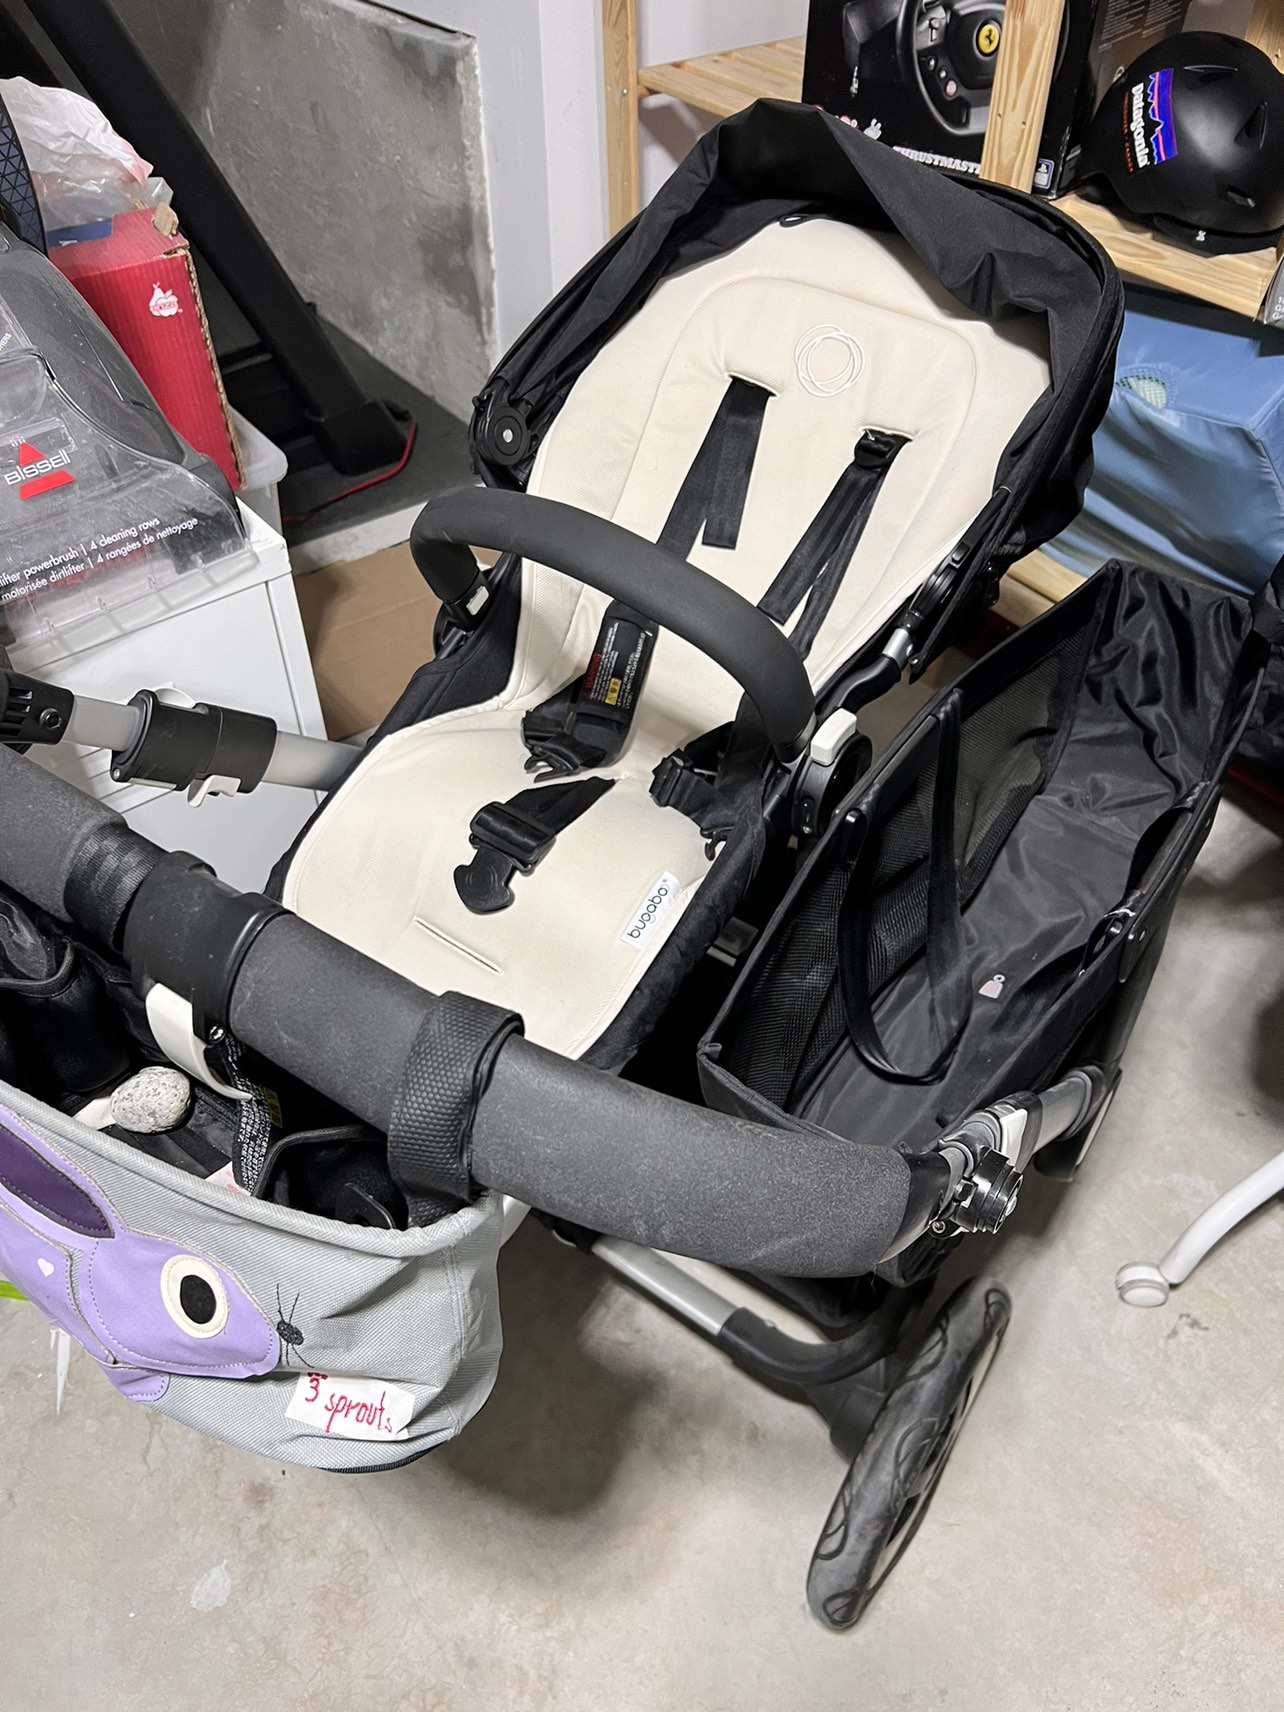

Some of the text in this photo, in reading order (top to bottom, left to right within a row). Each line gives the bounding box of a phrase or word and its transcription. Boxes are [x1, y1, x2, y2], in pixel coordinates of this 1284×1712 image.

[1130, 82, 1149, 168] patagonia
[1, 578, 48, 601] motorisée
[50, 562, 85, 582] dirtlifter
[97, 555, 104, 564] 4
[105, 540, 142, 561] rangées
[143, 532, 155, 547] de
[156, 517, 198, 542] nettoyage
[24, 547, 79, 580] powerbrush
[90, 541, 98, 550] 4
[99, 526, 138, 548] cleaning
[138, 518, 160, 532] rows
[305, 1377, 392, 1433] 3 sprouts
